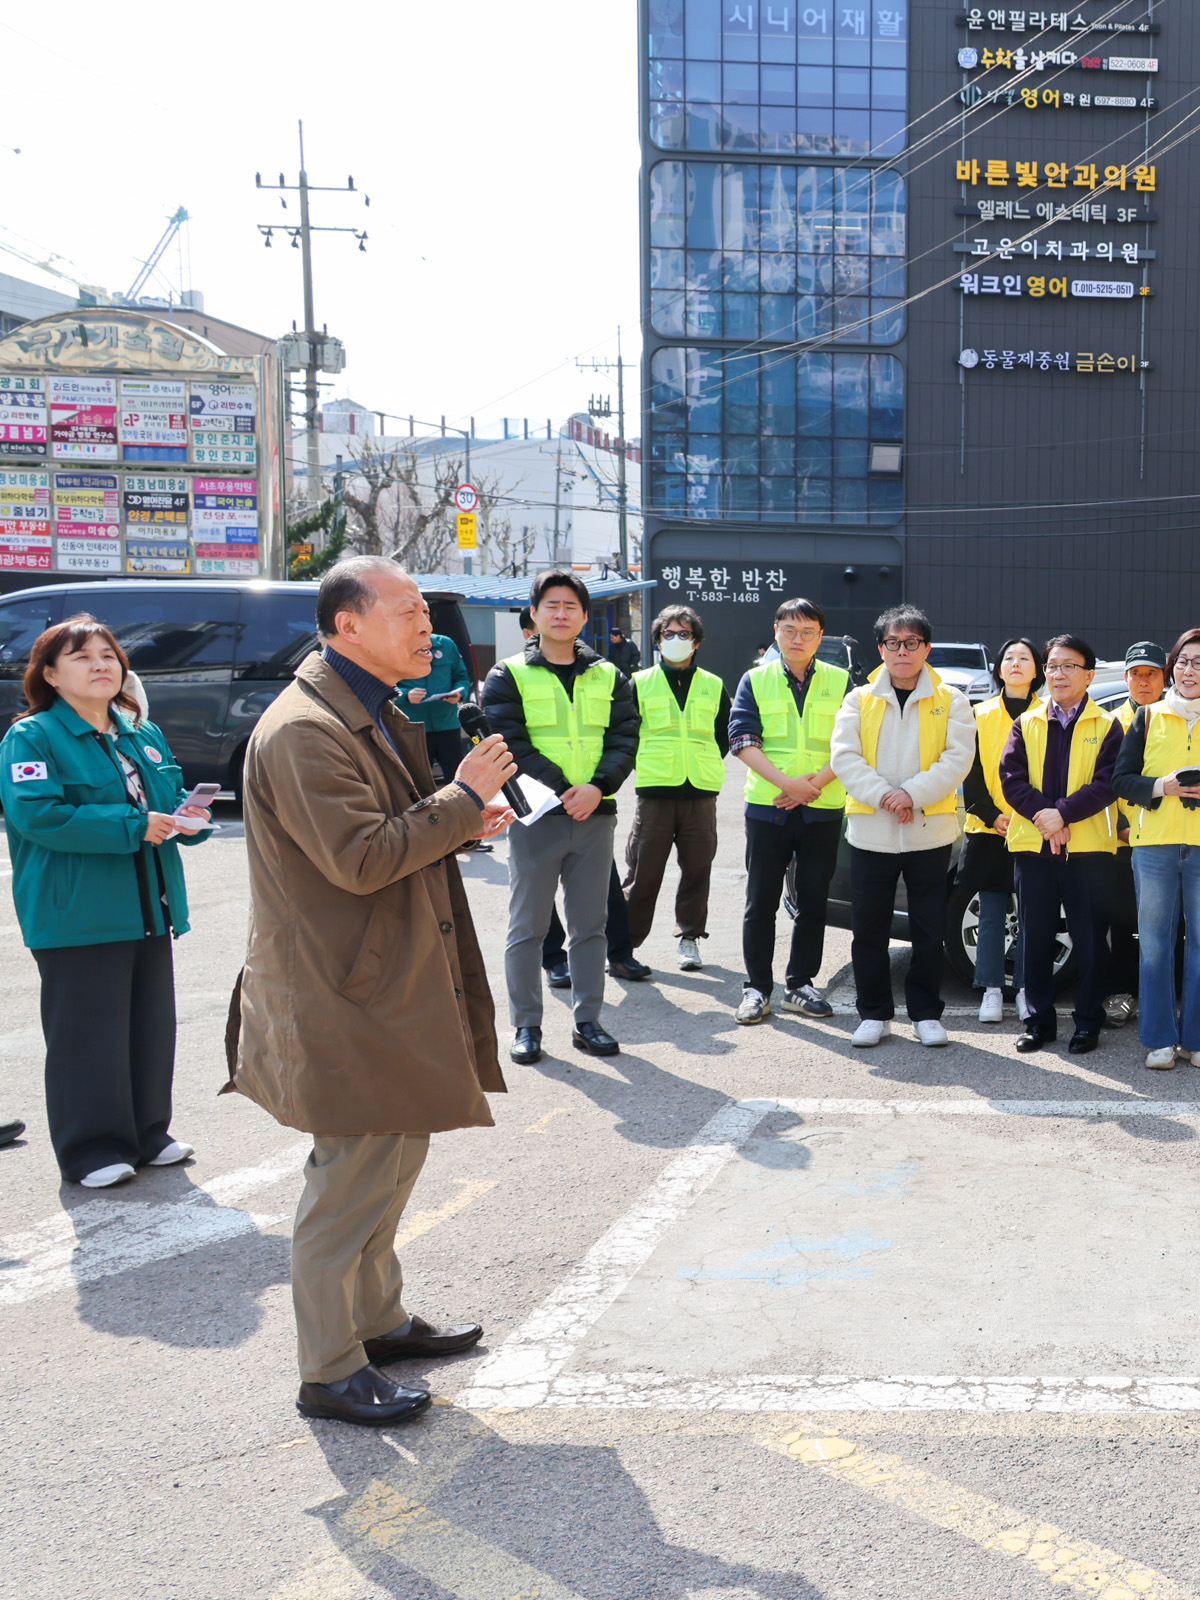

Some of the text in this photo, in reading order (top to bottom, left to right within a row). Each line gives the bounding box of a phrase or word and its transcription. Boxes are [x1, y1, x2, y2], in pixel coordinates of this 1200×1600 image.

[728, 4, 903, 36] 시니어재활
[967, 8, 1088, 31] 윤앤필라테스
[1139, 23, 1149, 32] 4F
[1110, 59, 1145, 69] 522-0608
[1147, 60, 1157, 69] 4F
[1020, 87, 1155, 109] 영어 학원 597-8880 4F
[956, 159, 1157, 192] 바른빛안과의원
[977, 200, 1137, 224] 엘레느 에스테틱 3F
[971, 238, 1139, 264] 고운이치과의원
[960, 274, 1150, 298] 워크인 영어 T.010-5215-0511 3F
[981, 349, 1070, 371] 동물제중원
[1076, 352, 1136, 373] 금손이
[209, 384, 231, 396] 영어
[126, 478, 186, 491] 김정남미용실
[199, 482, 252, 493] 서초무용학원
[174, 497, 186, 506] 4F
[459, 491, 473, 504] 30
[13, 506, 48, 518] 줄넘기
[202, 511, 237, 520] 전당포
[20, 521, 47, 531] 부동산
[87, 526, 106, 536] 미술
[61, 541, 117, 552] 신동아 인테리어
[68, 557, 110, 568] 대우부동산
[201, 560, 226, 573] 행복
[661, 566, 787, 591] 행복한 반찬
